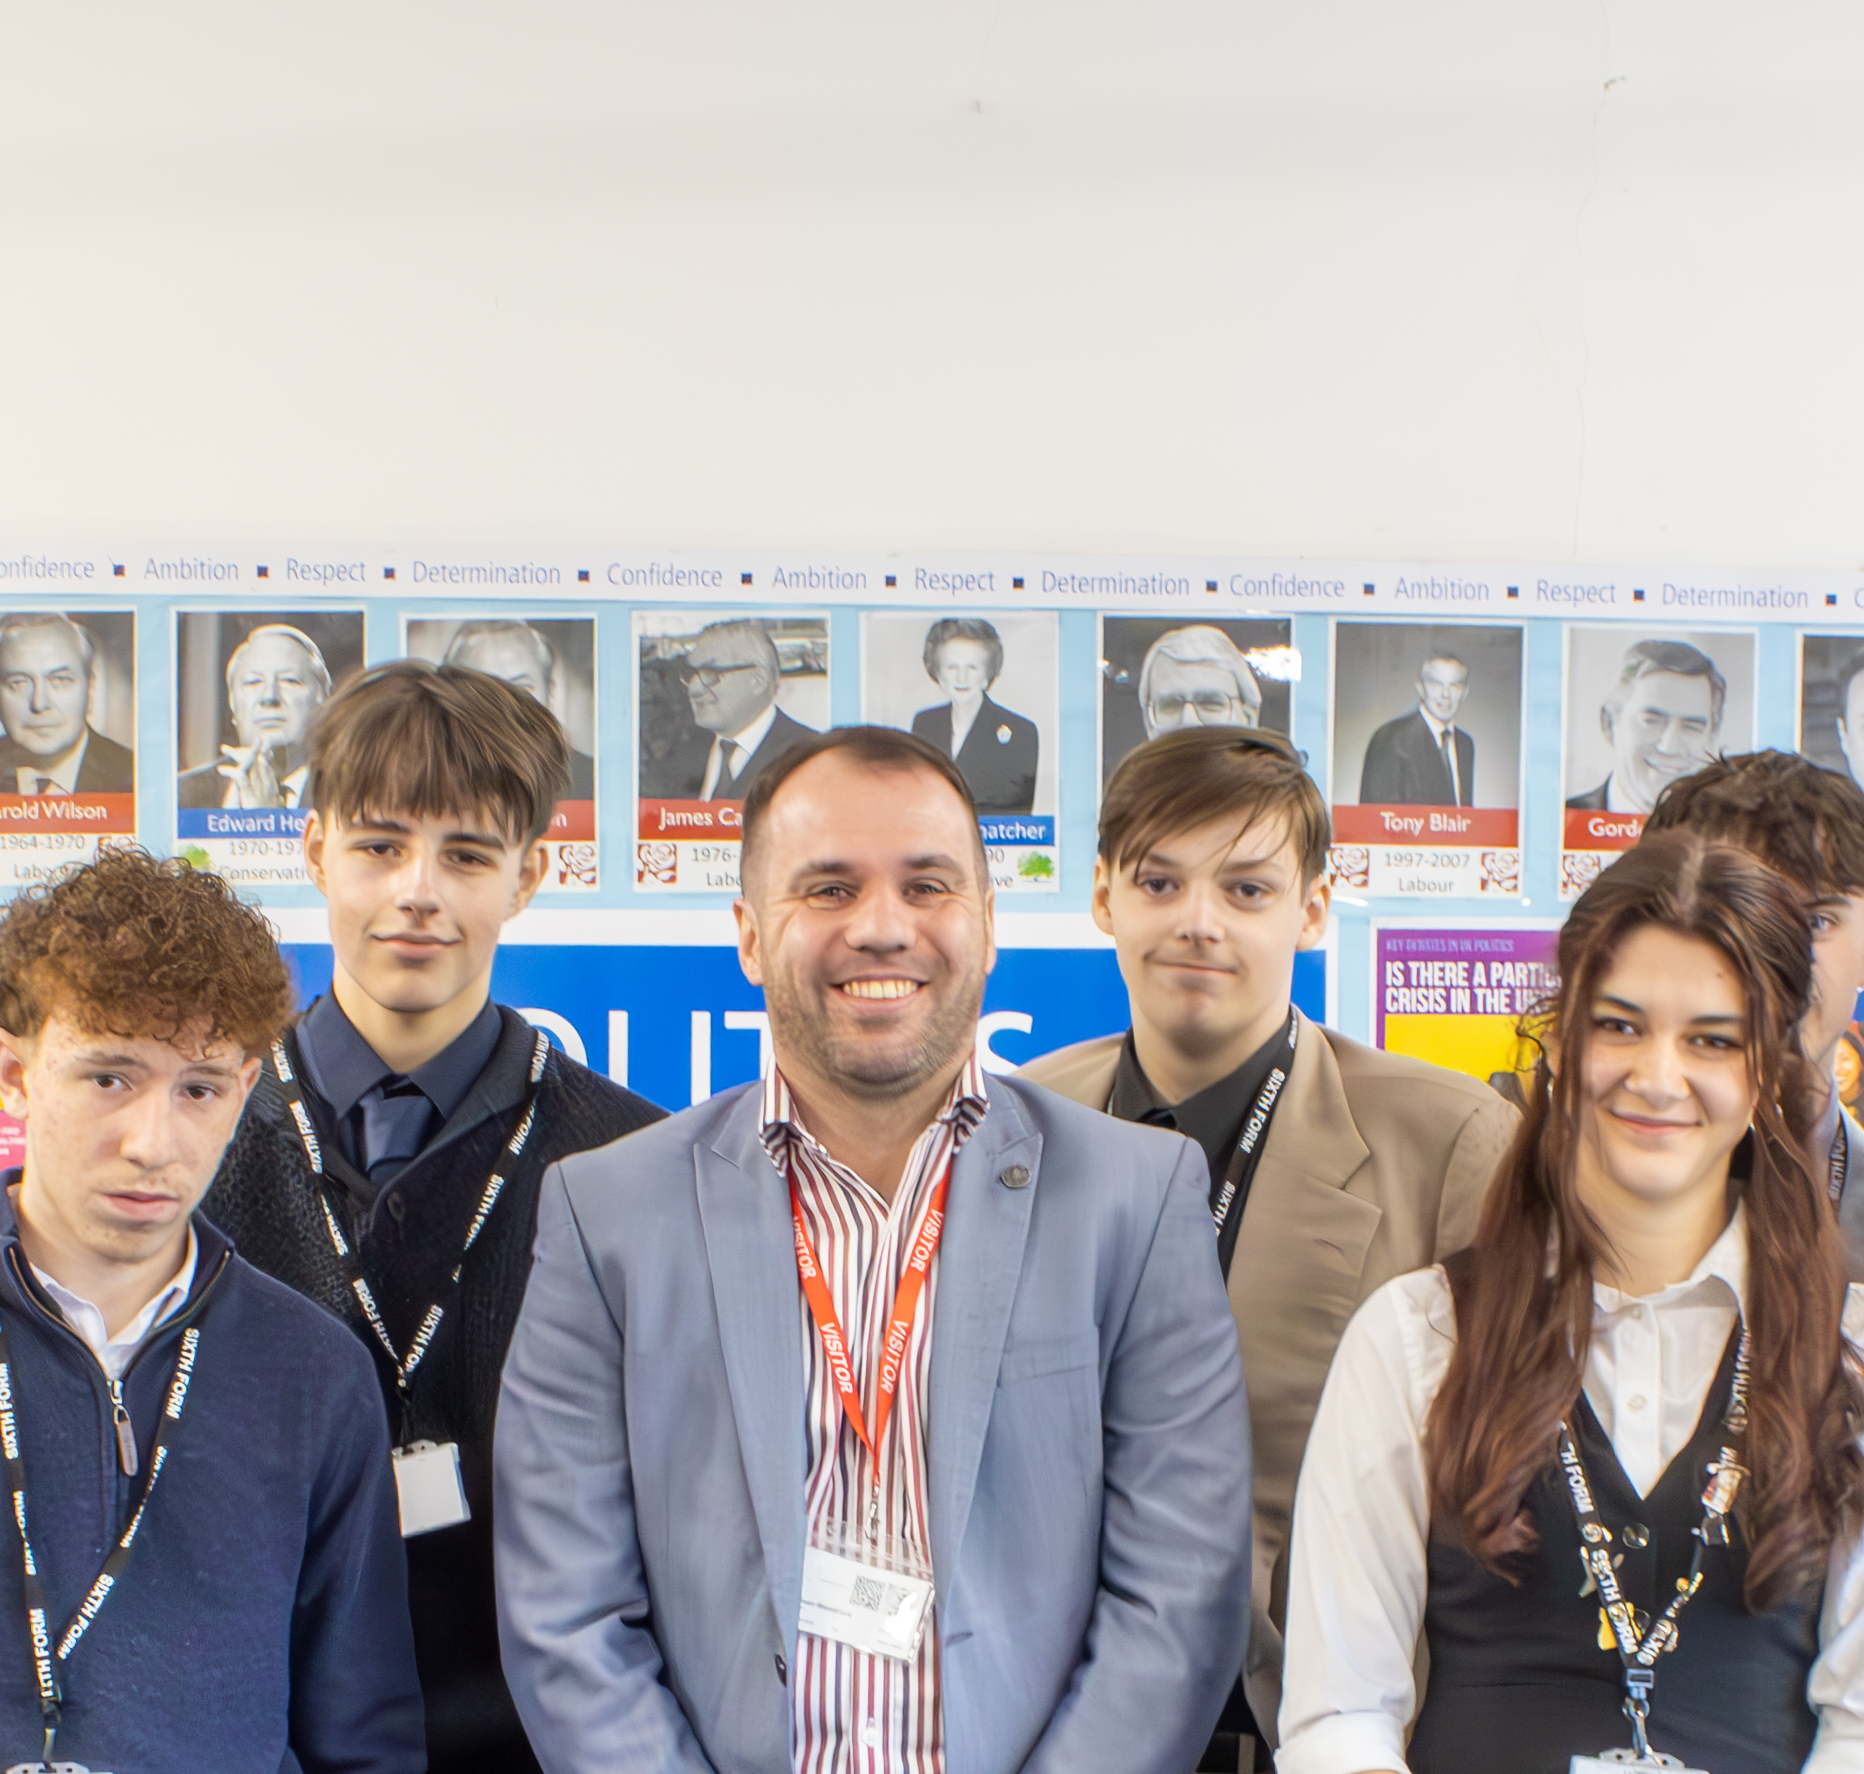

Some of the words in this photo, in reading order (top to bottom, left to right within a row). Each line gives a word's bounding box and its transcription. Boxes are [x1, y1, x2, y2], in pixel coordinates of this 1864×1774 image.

[144, 557, 239, 580] Ambition
[287, 558, 366, 586] Respect
[413, 561, 560, 584] Determination
[607, 562, 723, 587] Confidence
[772, 566, 867, 589] Ambition
[915, 568, 995, 596] Respect
[1042, 570, 1189, 595] Determination
[1229, 574, 1345, 597] Confidence
[1395, 577, 1489, 600] Ambition
[1537, 579, 1615, 607] Respect
[1662, 583, 1808, 608] Determination
[42, 800, 107, 820] Wilson
[207, 813, 275, 833] Edward
[658, 807, 712, 830] James
[1381, 812, 1424, 836] Tony
[1429, 812, 1471, 833] Blair
[0, 835, 85, 851] 1964-1970
[1384, 852, 1470, 869] 1997-2007
[1398, 876, 1454, 894] Labour
[1385, 960, 1404, 987] IS
[1409, 960, 1469, 987] THERE
[1472, 962, 1486, 987] A
[1385, 987, 1446, 1013] CRISIS
[1450, 988, 1471, 1013] IN
[1474, 988, 1511, 1014] THE
[1238, 1108, 1268, 1154] FORM
[910, 1208, 946, 1274] VISITOR
[176, 1328, 201, 1376] SIXTH
[819, 1320, 854, 1396] VISITOR
[880, 1320, 909, 1396] VISITOR
[165, 1374, 188, 1420] FORM
[0, 1411, 19, 1460] SIXTH
[1566, 1464, 1593, 1514] FORM
[82, 1573, 115, 1618] SIXTH
[58, 1616, 88, 1660] FORM
